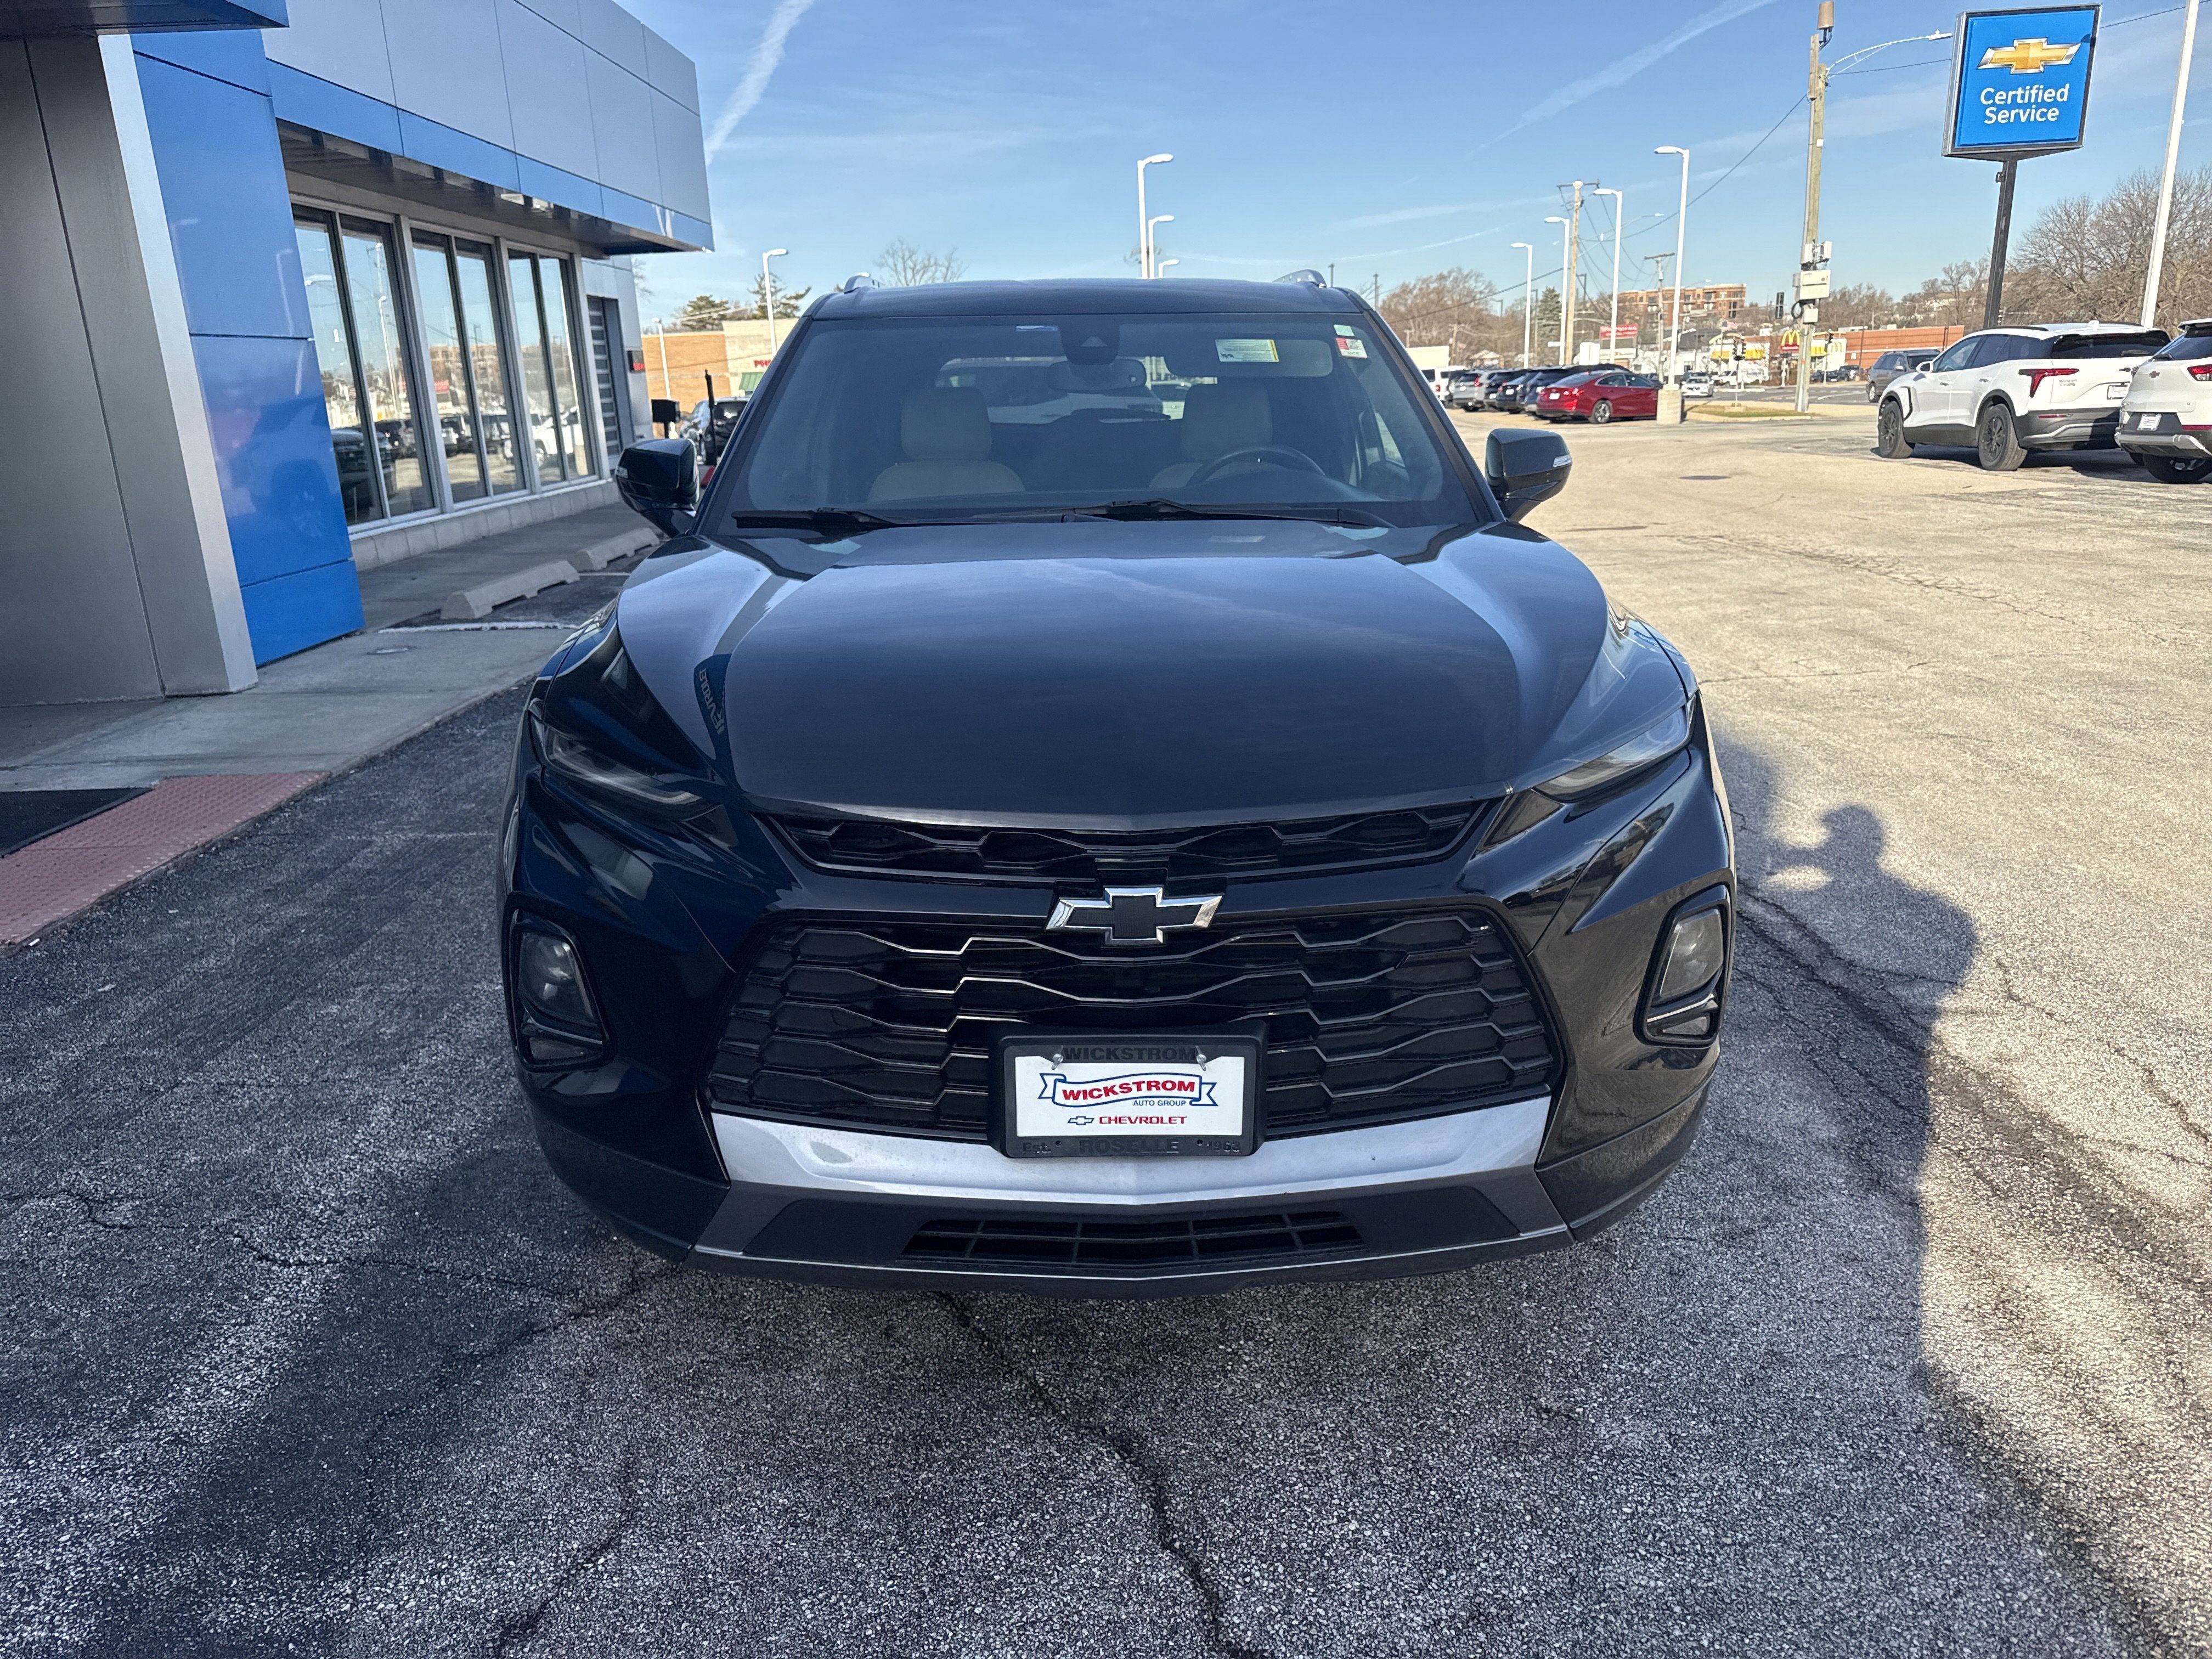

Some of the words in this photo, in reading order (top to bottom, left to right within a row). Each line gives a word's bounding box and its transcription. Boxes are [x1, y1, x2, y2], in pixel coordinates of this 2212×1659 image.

[1980, 83, 2069, 105] Certified
[1984, 104, 2059, 124] Service
[1062, 1047, 1196, 1060] WICKSTROM
[1062, 1080, 1195, 1101] WICKSTROM
[1099, 1116, 1187, 1125] CHEVROLET
[1022, 1142, 1052, 1153] Est.
[1079, 1138, 1179, 1154] ROSELLE
[1206, 1141, 1242, 1153] 1963
